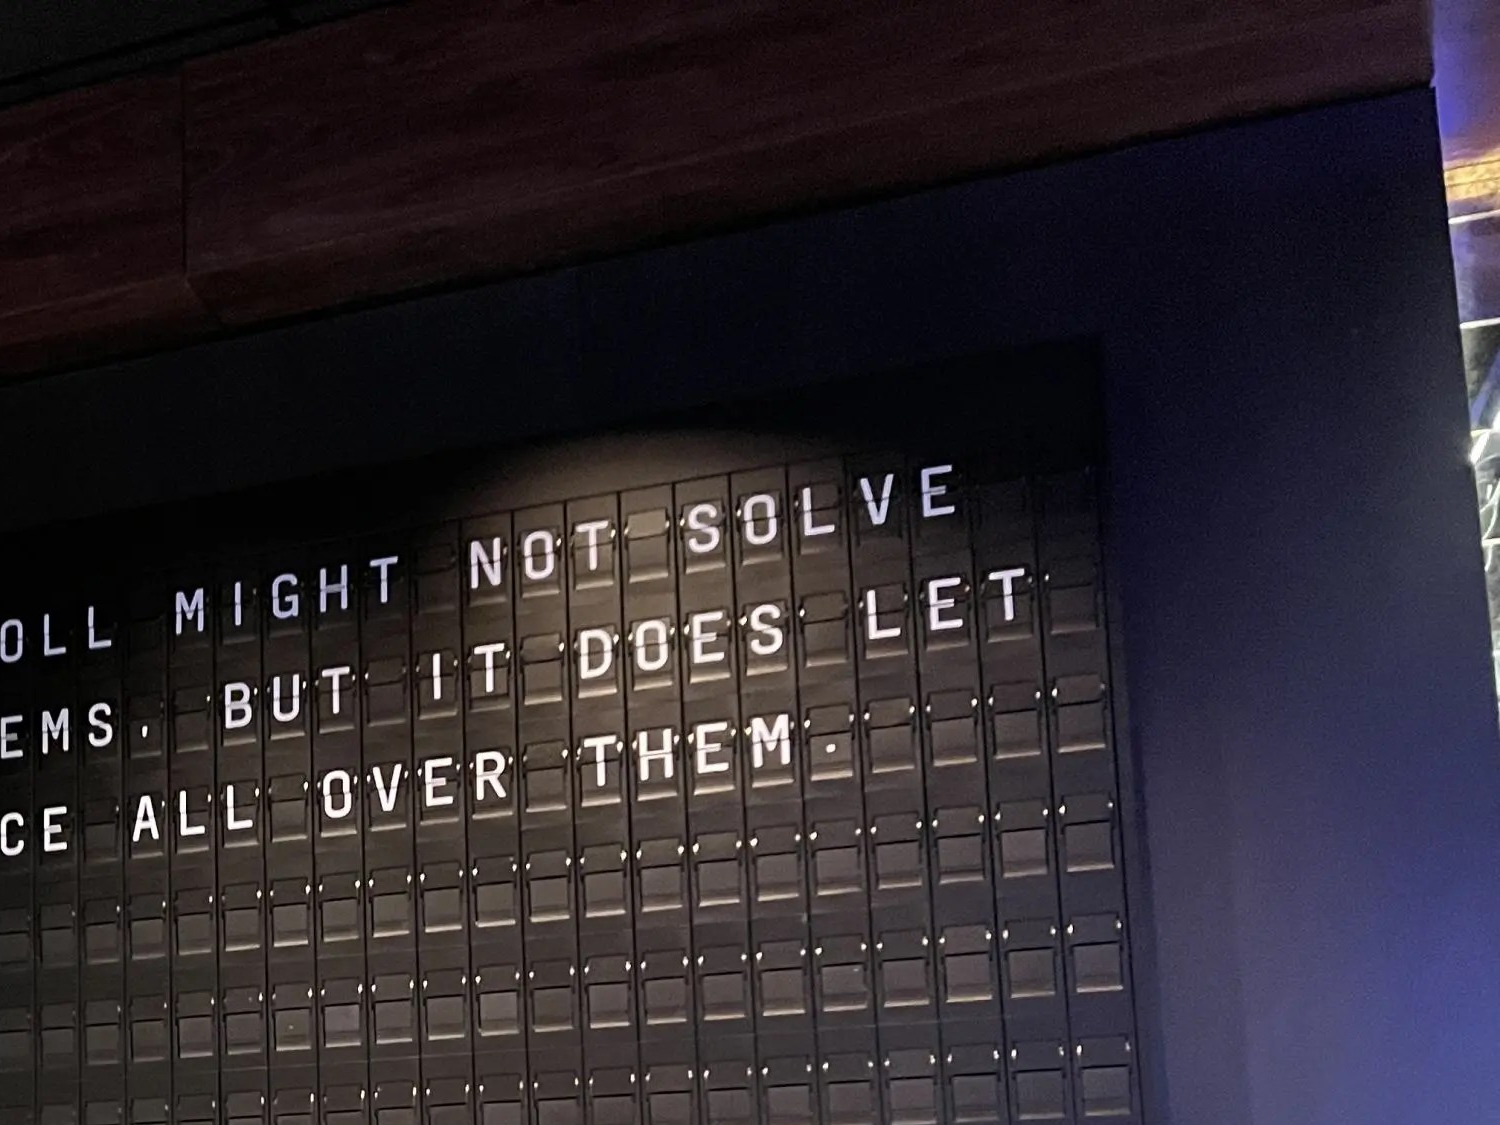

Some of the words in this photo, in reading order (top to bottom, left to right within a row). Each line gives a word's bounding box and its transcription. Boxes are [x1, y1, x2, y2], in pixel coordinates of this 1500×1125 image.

[174, 555, 398, 635] MIGHT
[469, 519, 609, 590] NOT
[687, 464, 956, 554] SOLVE
[225, 666, 351, 729] BUT
[432, 643, 506, 700] IT
[579, 604, 783, 679] DOES
[866, 567, 1027, 639] LET
[132, 784, 254, 842] ALL
[323, 750, 507, 819] OVER
[584, 714, 837, 787] THEM.
